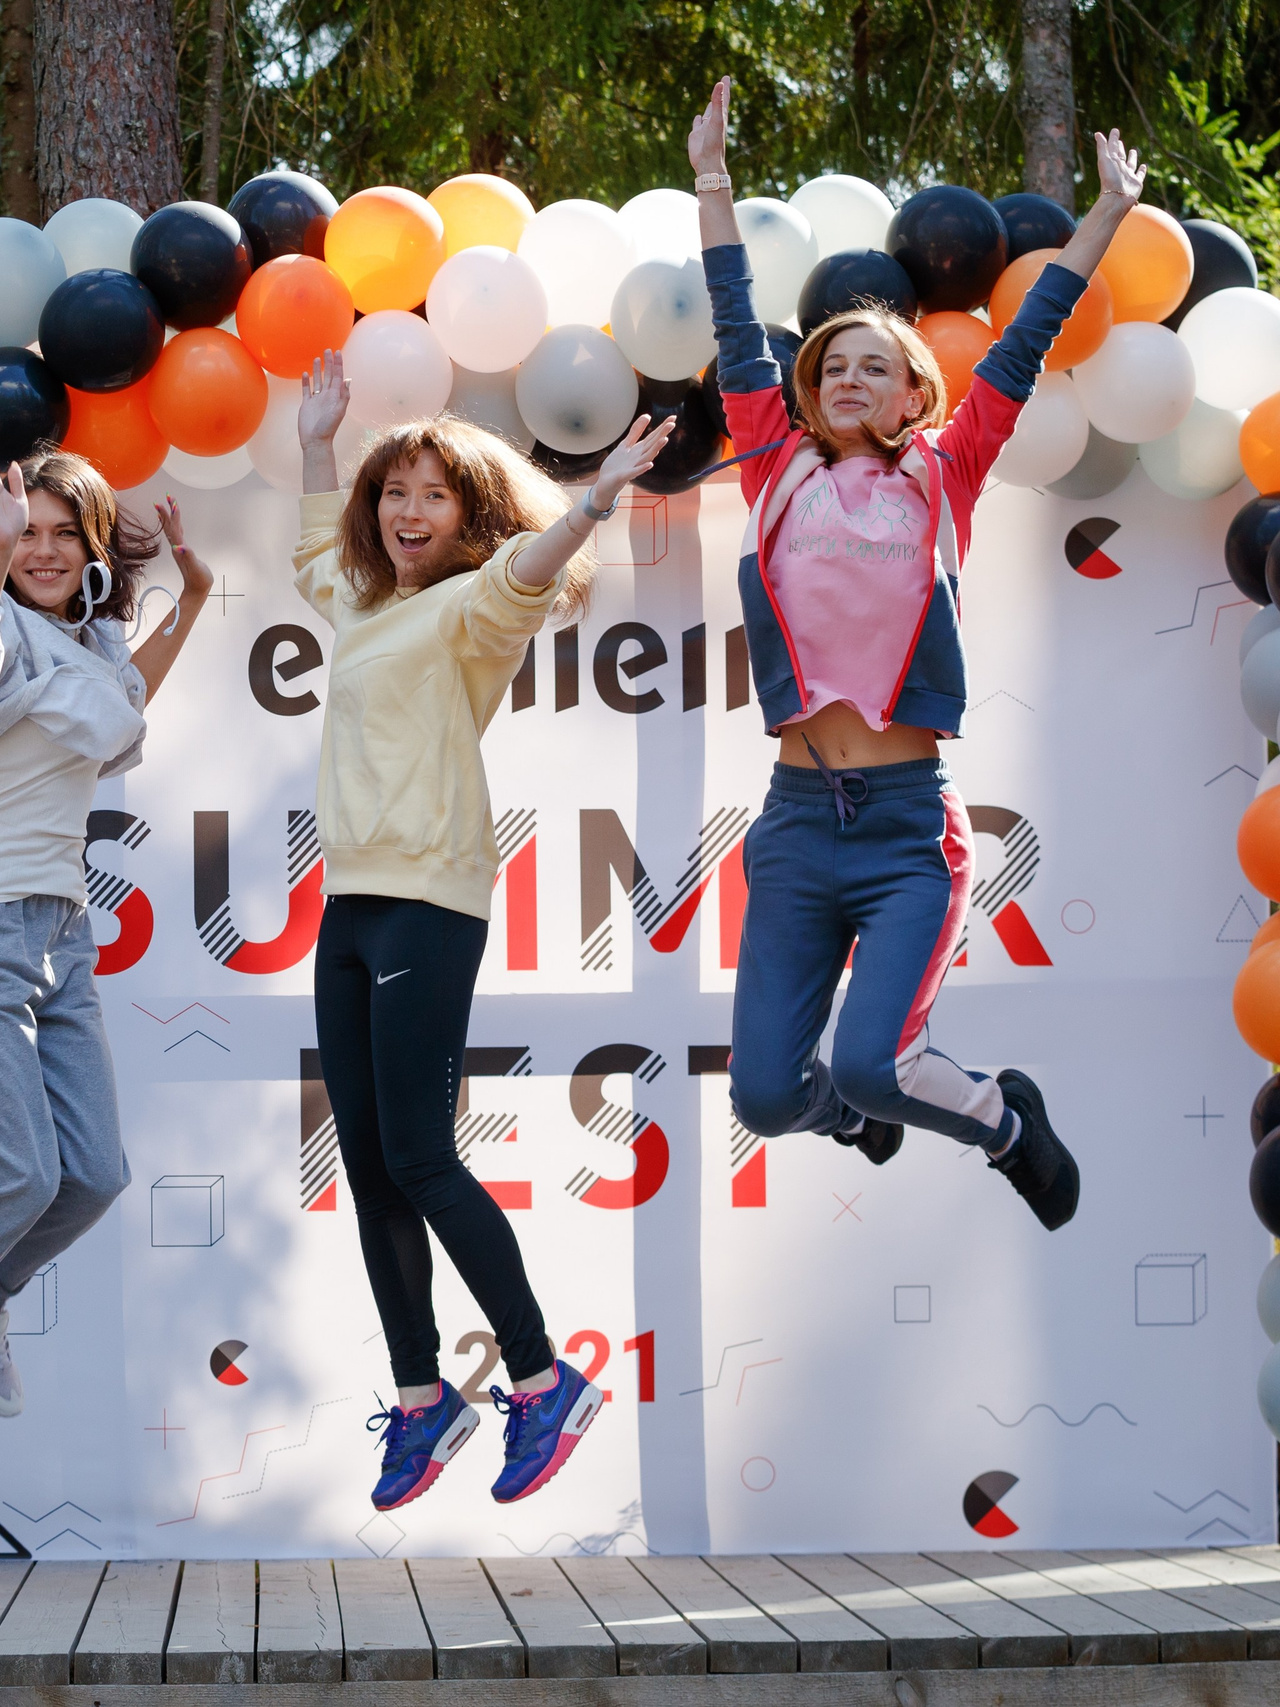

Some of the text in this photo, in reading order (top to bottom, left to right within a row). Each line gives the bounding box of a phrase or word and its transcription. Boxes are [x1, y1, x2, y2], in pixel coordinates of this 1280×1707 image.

[788, 535, 919, 561] БЕРЕГИ КАМЧАТКУ
[248, 622, 751, 717] emen
[85, 806, 1054, 976] SUMR
[454, 1329, 655, 1403] 221
